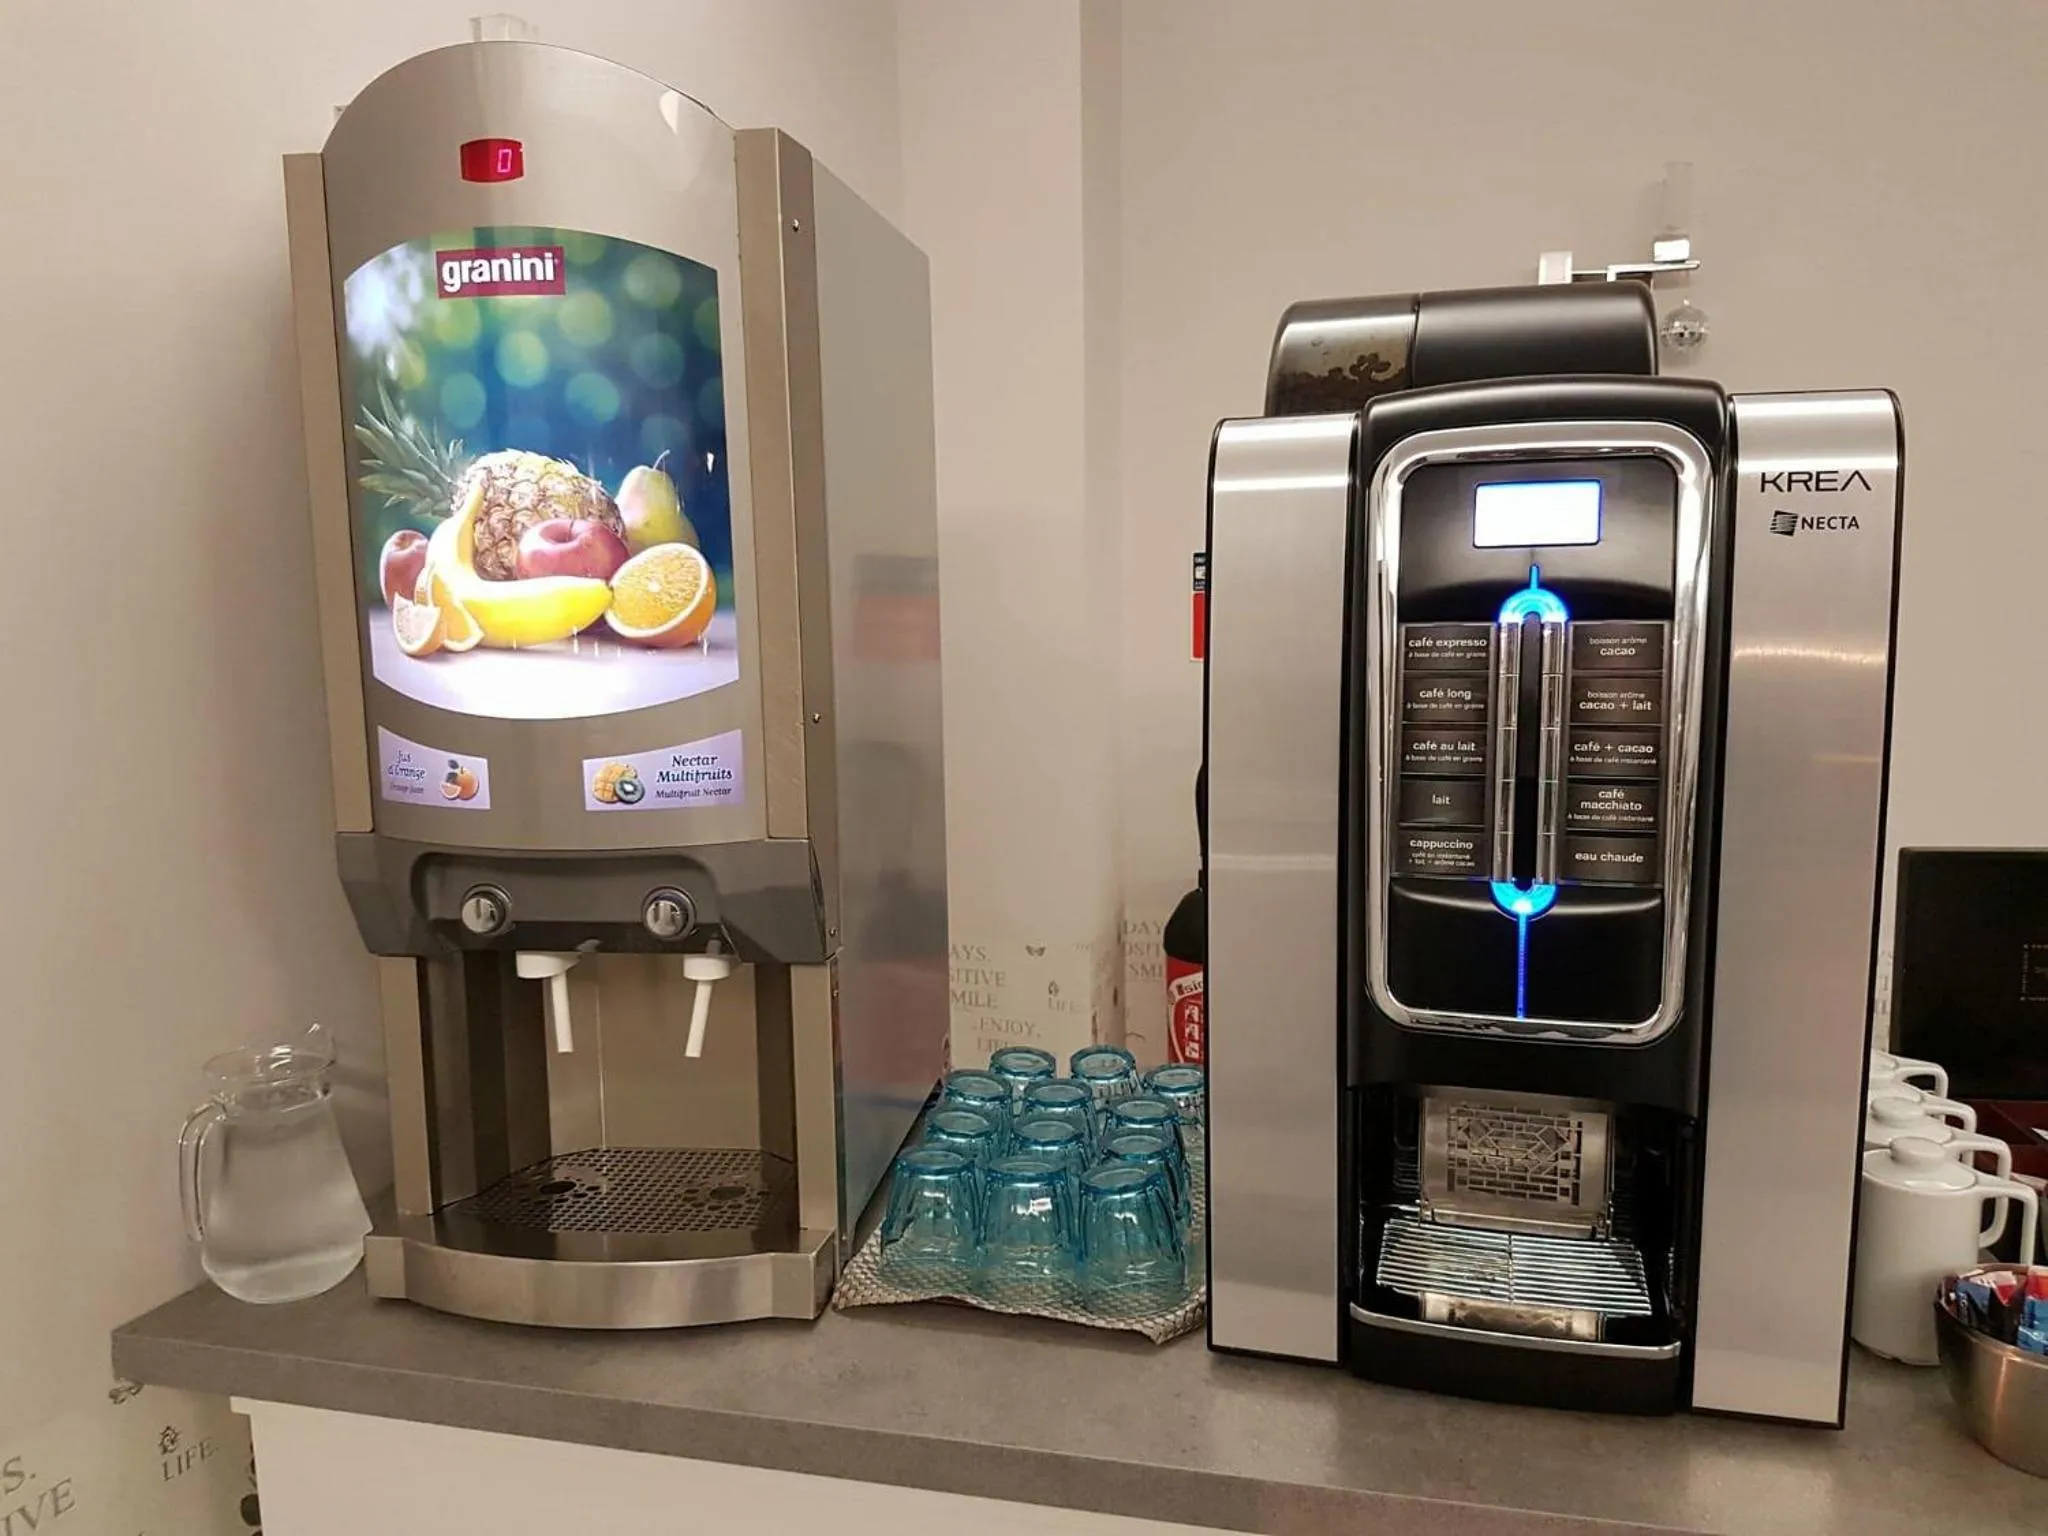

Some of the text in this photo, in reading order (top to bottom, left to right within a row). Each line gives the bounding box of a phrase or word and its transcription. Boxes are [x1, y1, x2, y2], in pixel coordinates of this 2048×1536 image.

[497, 148, 512, 173] 0
[441, 252, 554, 292] granini
[1760, 470, 1872, 493] KREA
[1801, 516, 1860, 530] NECTA
[1408, 637, 1487, 648] café expresso
[1600, 647, 1636, 656] cacao
[1420, 688, 1471, 700] café long
[1579, 701, 1615, 710] cacao
[1632, 700, 1652, 711] lait
[1413, 740, 1476, 751] café au lait
[1574, 741, 1600, 752] café
[1617, 744, 1653, 753] cacao
[671, 754, 718, 768] Nectar
[656, 767, 733, 784] Multifruits
[703, 787, 732, 797] Nectar
[1598, 788, 1625, 799] café
[1432, 794, 1451, 805] lait
[1580, 800, 1642, 811] macchiato
[1410, 839, 1474, 850] cappuccino
[1575, 852, 1644, 863] eau chaude
[950, 967, 1005, 987] ITIVE
